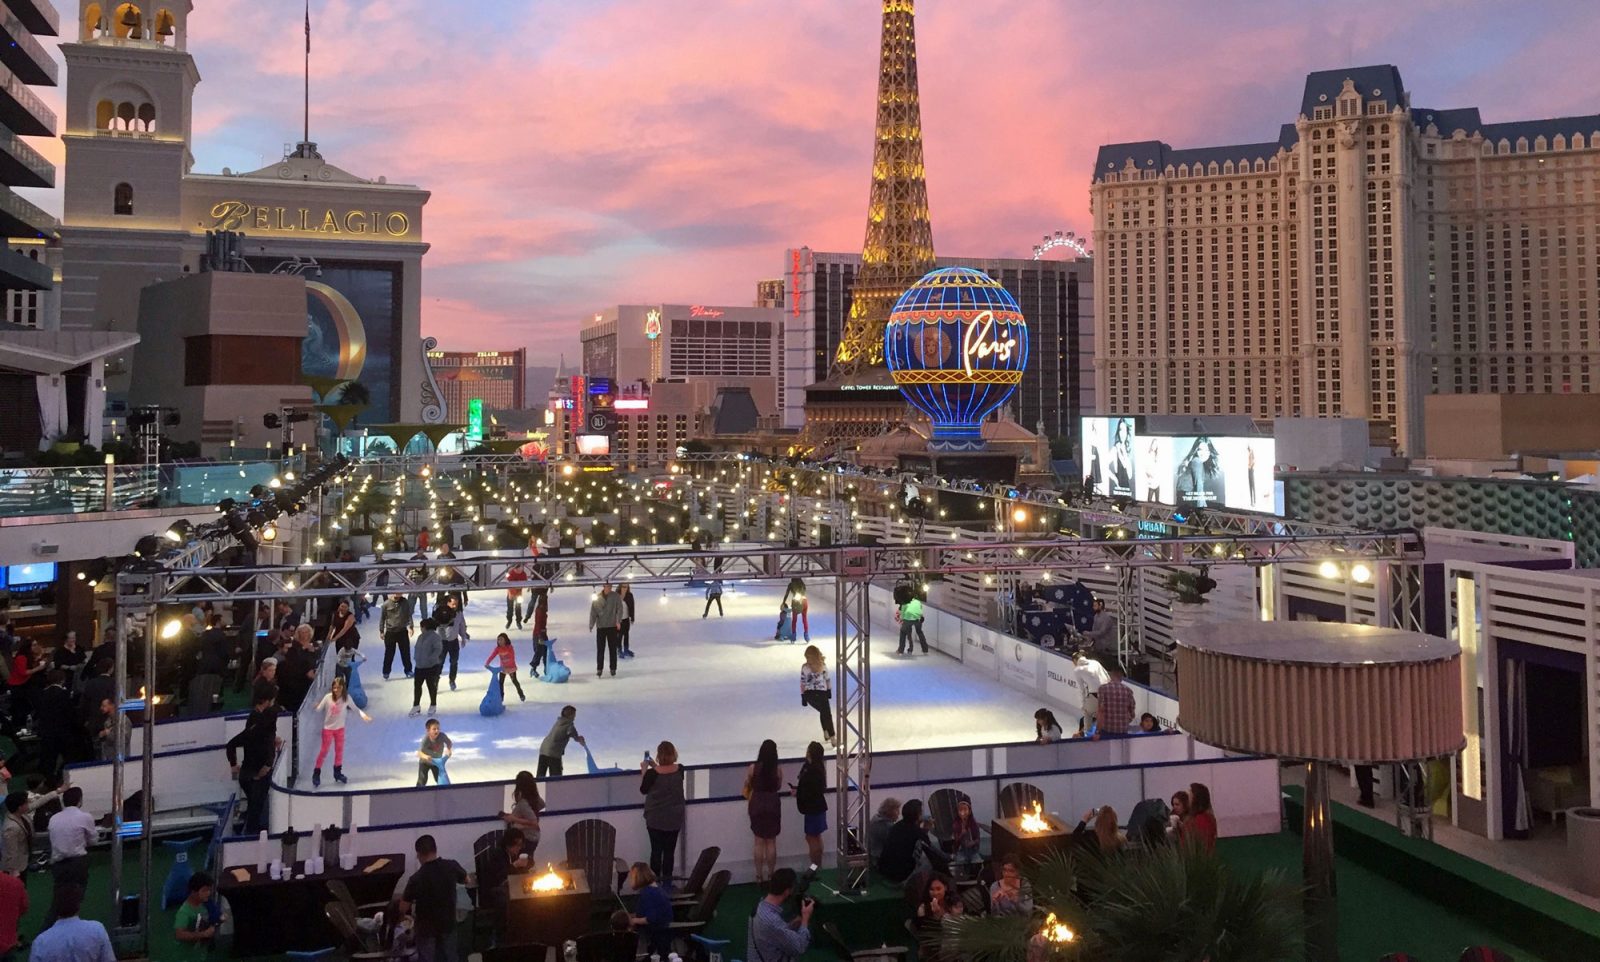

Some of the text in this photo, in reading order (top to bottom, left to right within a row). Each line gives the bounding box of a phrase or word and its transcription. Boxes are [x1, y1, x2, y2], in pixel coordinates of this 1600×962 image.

[200, 201, 409, 236] BELLAGIO
[964, 310, 1016, 377] Paris
[1138, 520, 1165, 533] URBAN
[1047, 670, 1063, 682] STELLA
